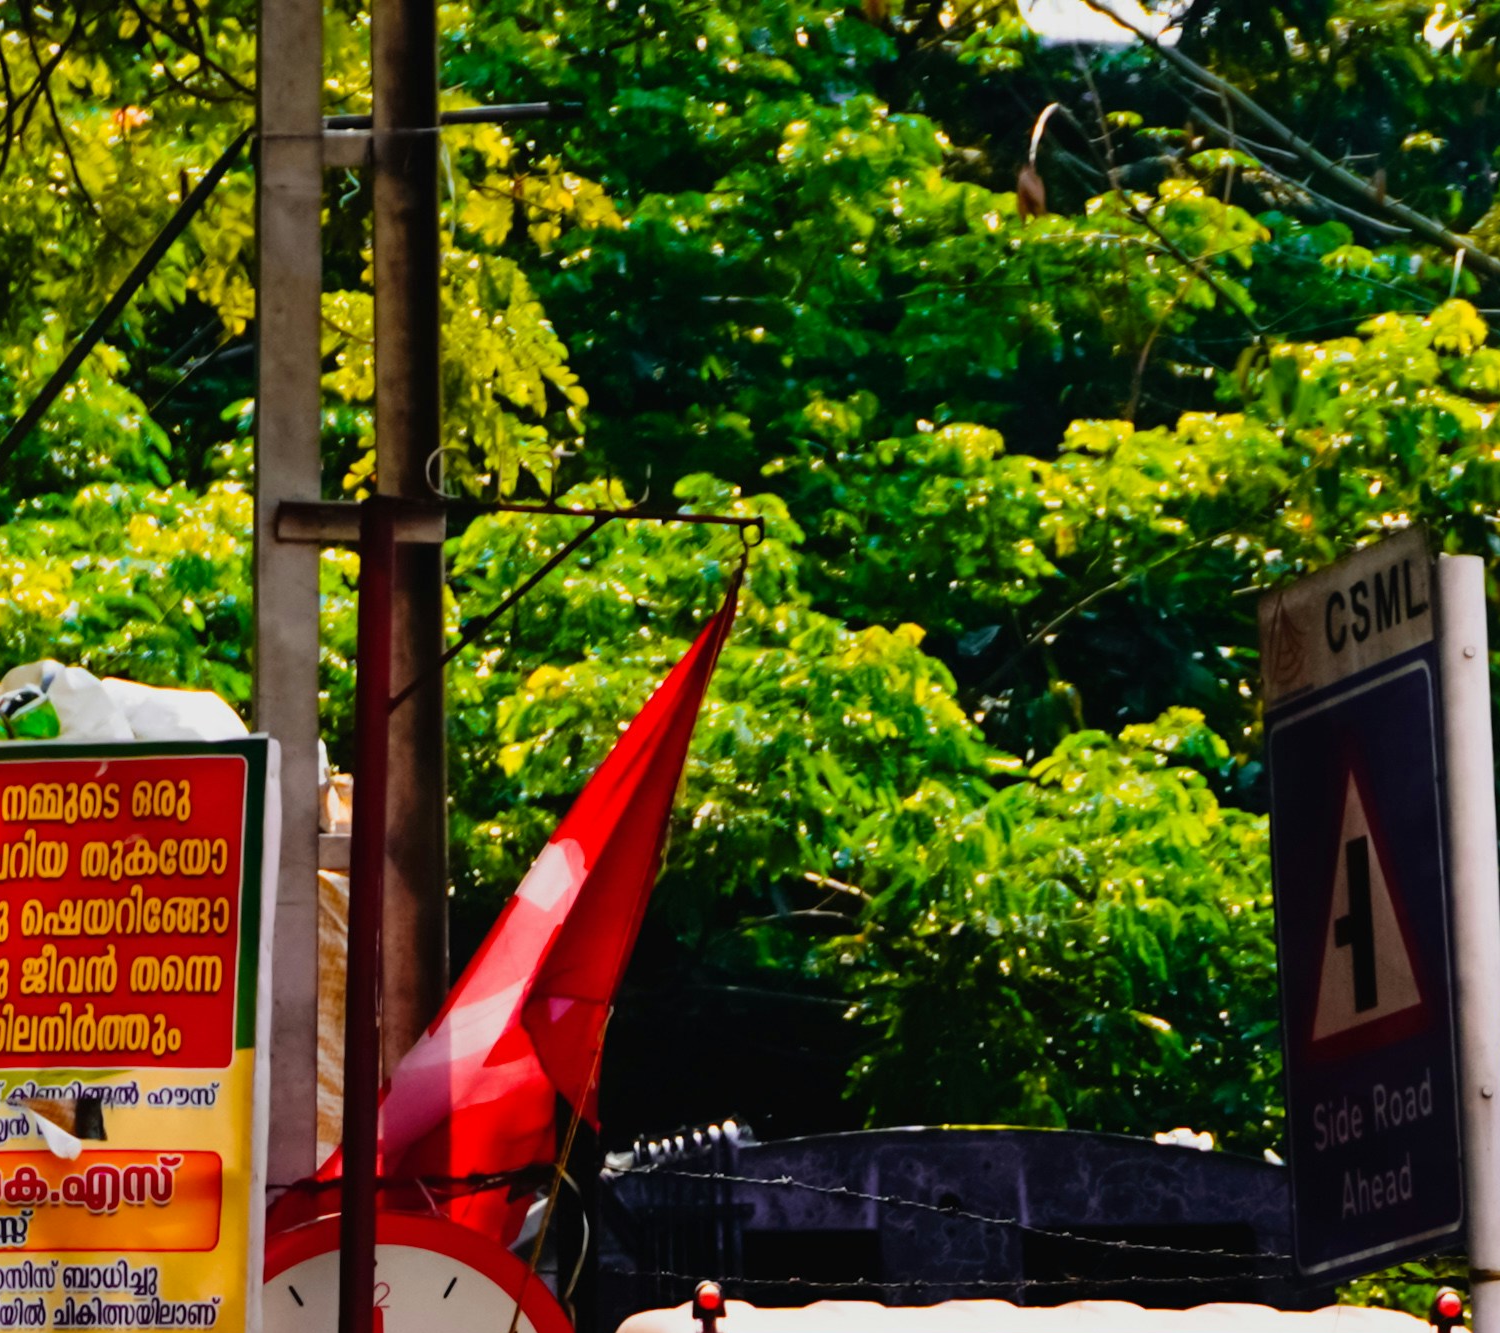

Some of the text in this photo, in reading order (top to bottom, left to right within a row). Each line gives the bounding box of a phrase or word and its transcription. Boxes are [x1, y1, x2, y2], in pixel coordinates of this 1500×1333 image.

[1325, 559, 1428, 653] CSML
[1, 780, 191, 824] നമ്മുടെ ഒരു
[81, 838, 227, 881] തുകയോ
[21, 884, 229, 936] ഷെയറിങ്ങോ
[20, 943, 118, 994] ജീവൻ
[130, 955, 223, 993] തന്നെ
[1313, 1066, 1434, 1151] Side Road
[1342, 1151, 1414, 1219] Ahead
